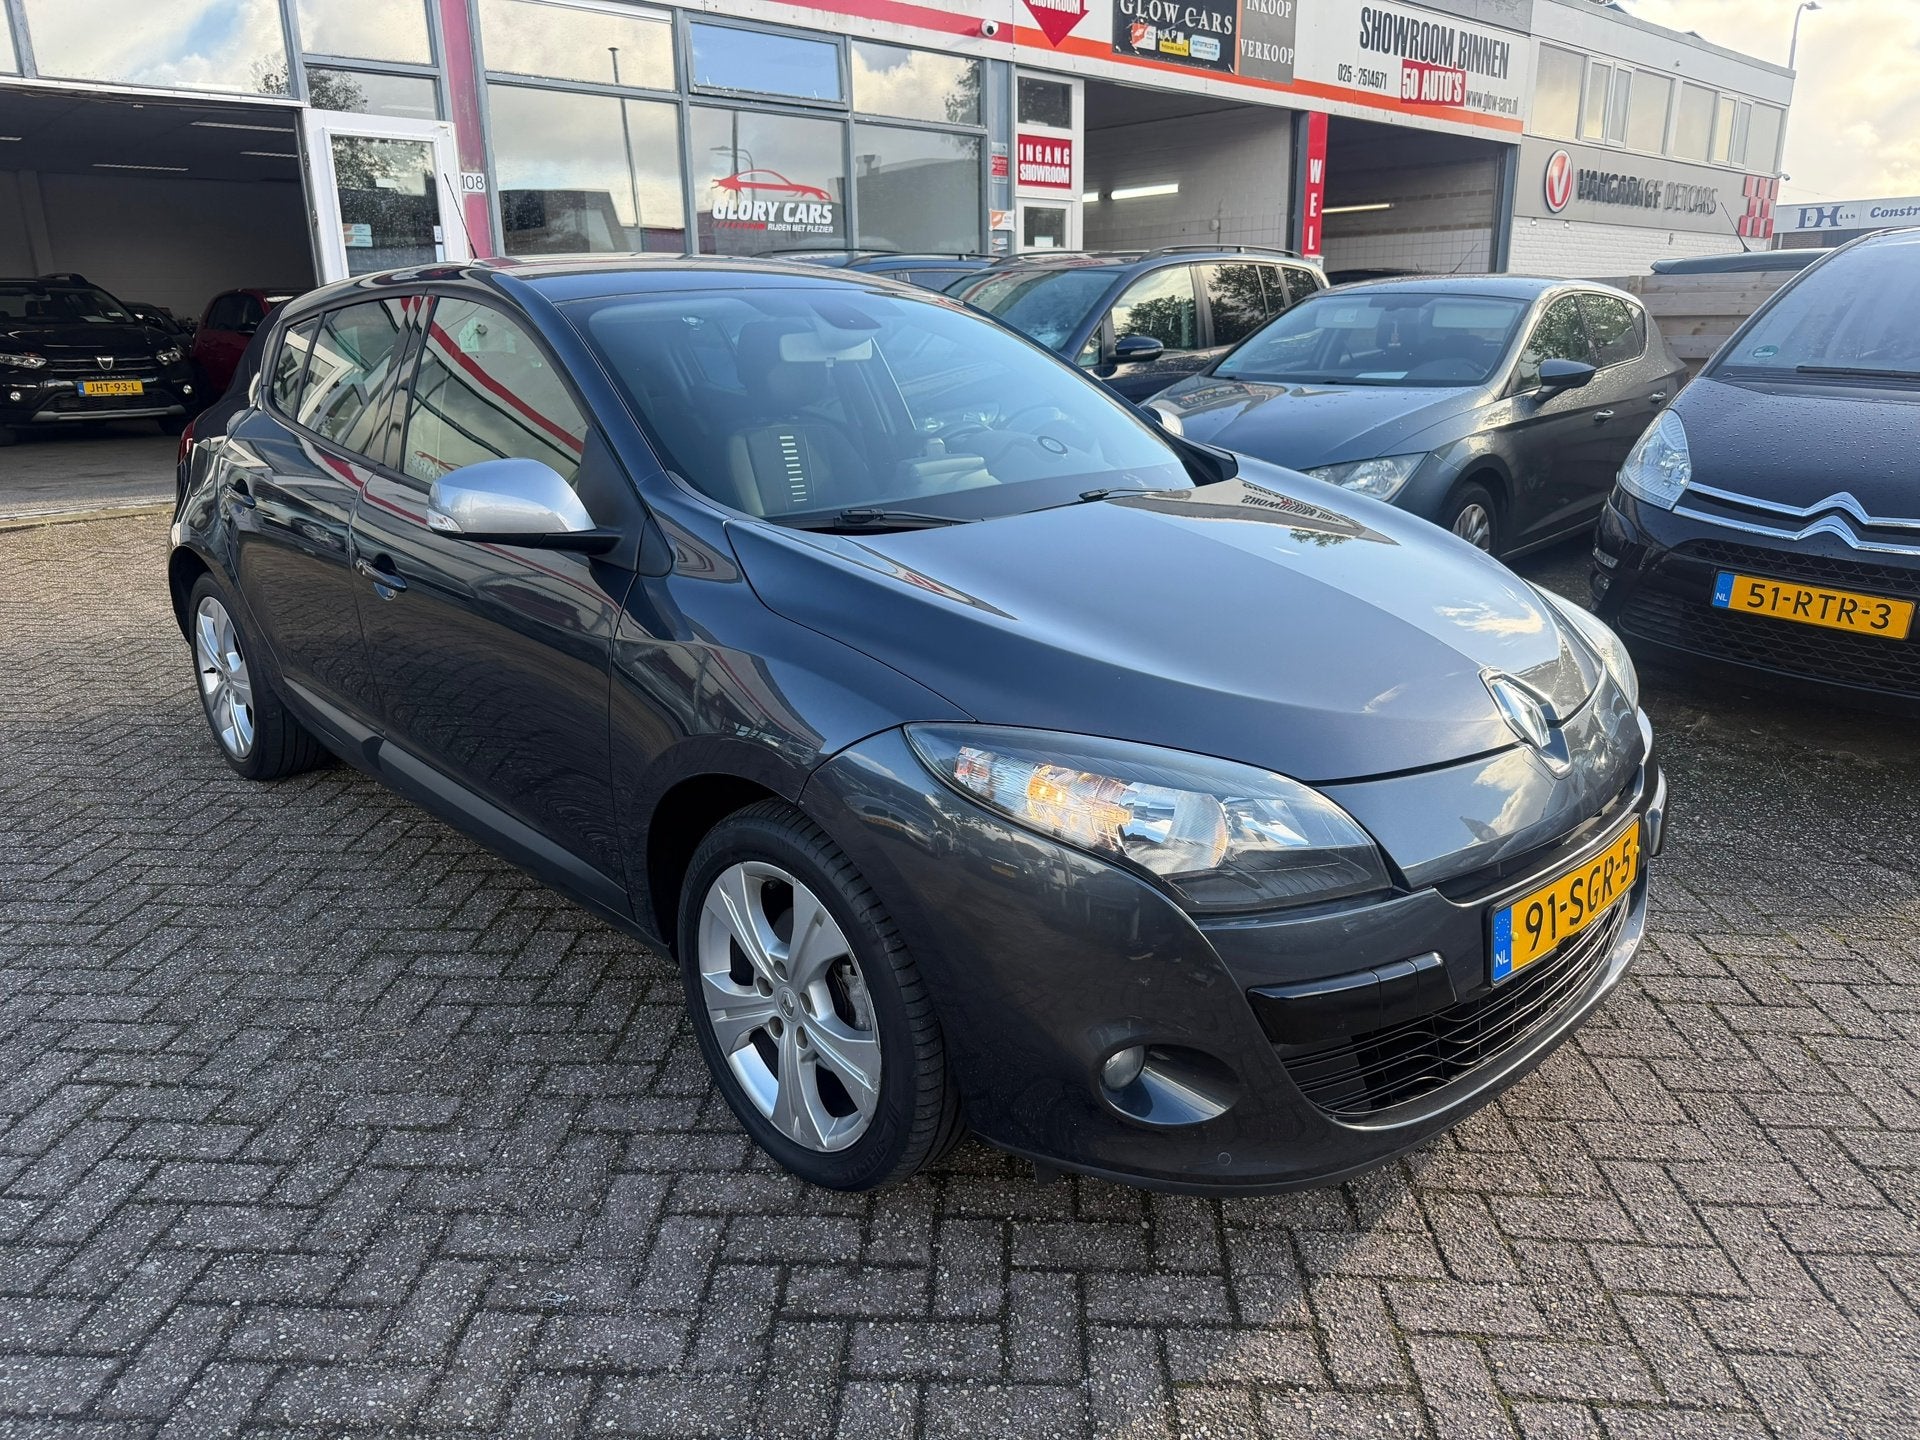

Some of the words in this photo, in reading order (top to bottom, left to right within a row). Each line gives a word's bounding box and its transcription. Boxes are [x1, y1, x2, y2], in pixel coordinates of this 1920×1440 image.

[1120, 0, 1180, 23] GLOW
[1185, 7, 1233, 35] CARS
[1246, 0, 1292, 18] INKOOP
[1240, 38, 1294, 65] VERKOOP
[1360, 7, 1455, 67] SHOWROOM
[1458, 32, 1510, 80] BINNEN
[1338, 63, 1352, 83] 025
[1402, 67, 1417, 100] 50
[1421, 71, 1462, 103] AUTO'S
[1020, 143, 1070, 165] INGANG
[462, 175, 486, 190] 108
[1020, 163, 1070, 184] SHOWROOM
[1577, 168, 1663, 209] VAKGARAGE
[712, 200, 780, 222] GLORY
[783, 202, 833, 224] CARS
[1870, 206, 1920, 218] Constr
[767, 223, 791, 231] RIJDEN
[792, 224, 806, 232] MET
[806, 225, 833, 233] PLEZIER
[90, 382, 138, 393] JHT-93-L
[1715, 592, 1728, 602] NL
[1747, 583, 1892, 630] 51-RTR-3
[1495, 953, 1509, 968] NL
[1525, 838, 1631, 953] 91-SGR-5
